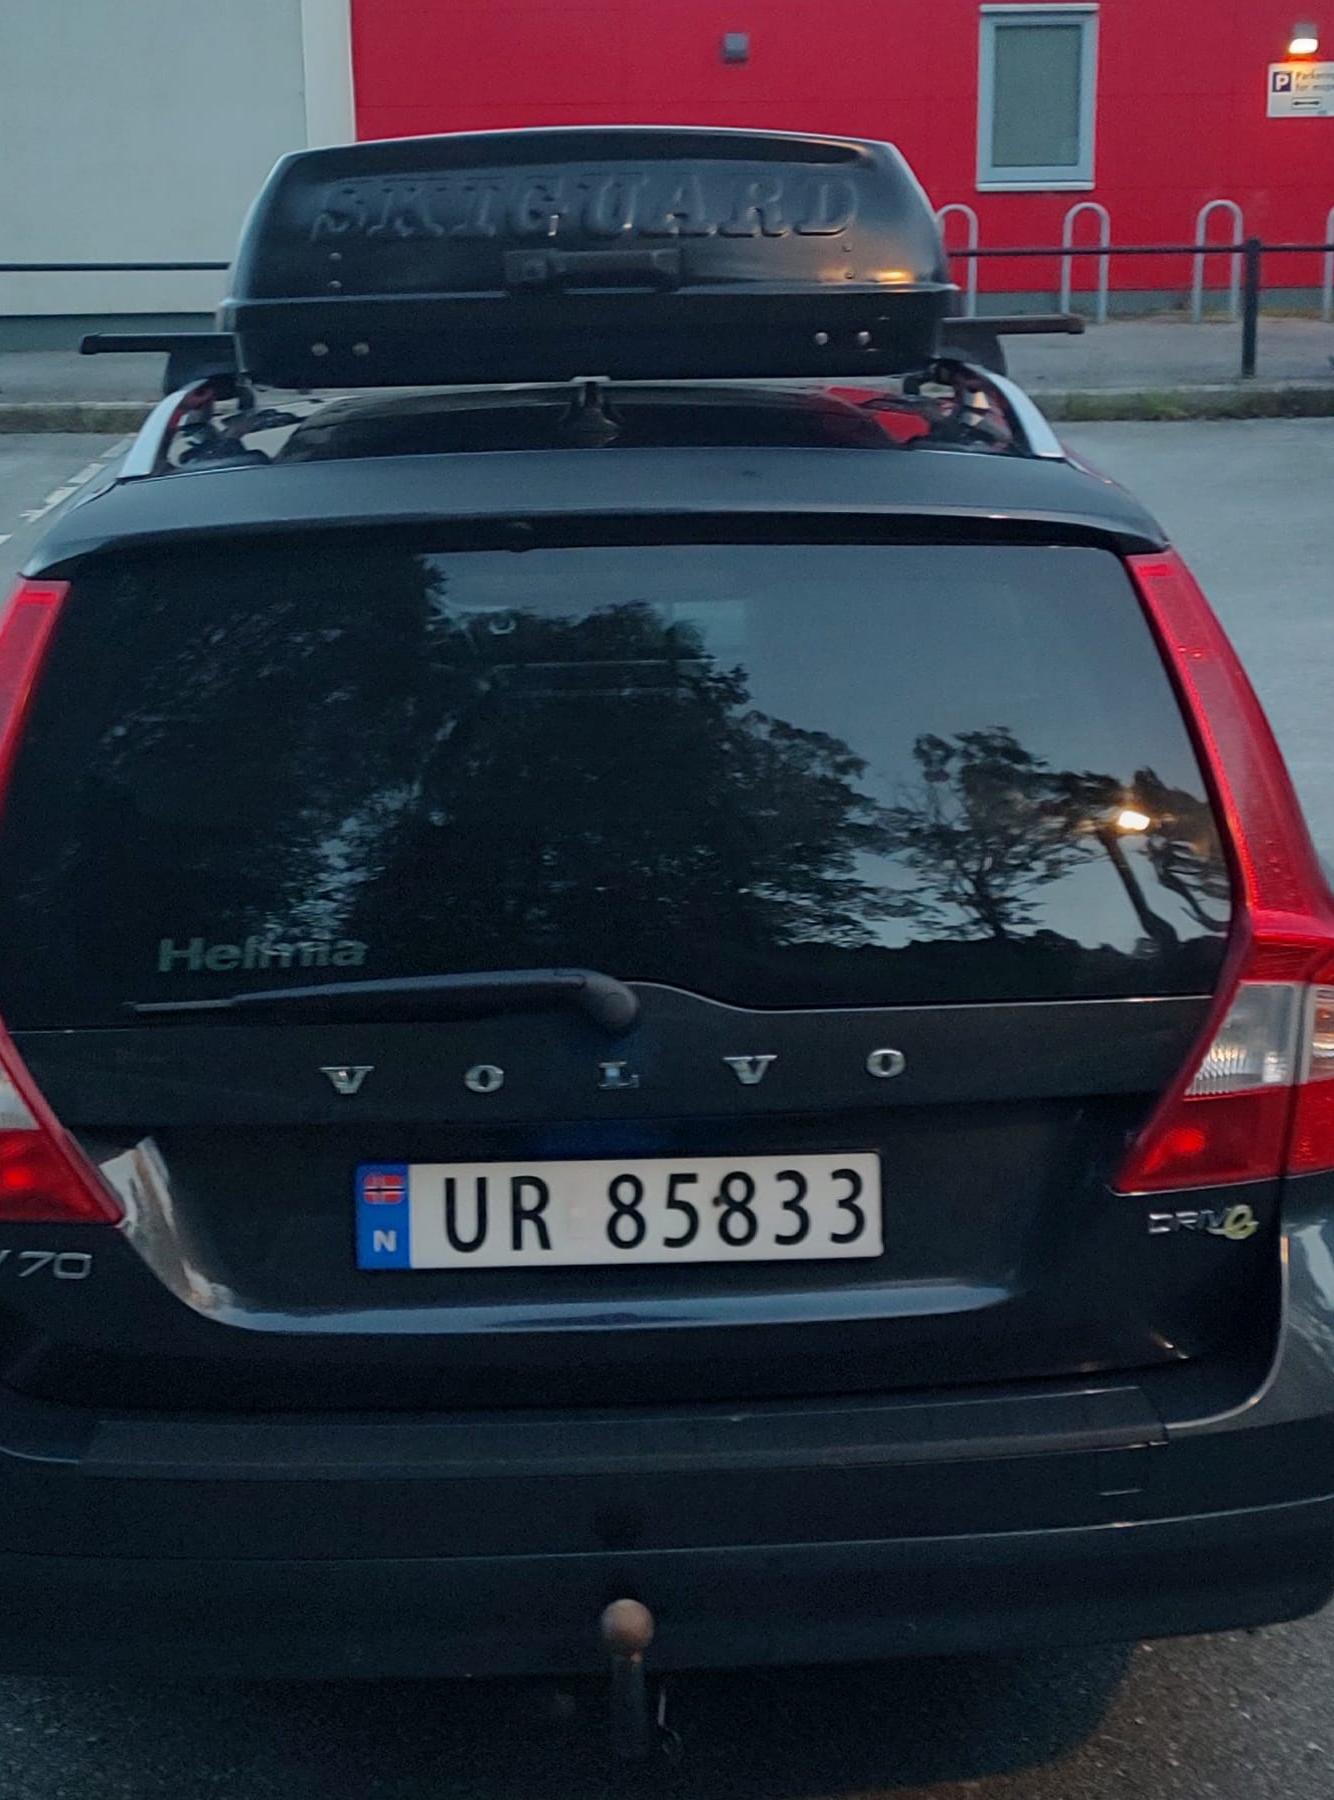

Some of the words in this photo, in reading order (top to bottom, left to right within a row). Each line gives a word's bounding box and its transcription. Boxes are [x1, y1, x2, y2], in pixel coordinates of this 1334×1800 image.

[1275, 73, 1289, 91] P
[310, 173, 860, 240] SKIGUARD
[319, 1047, 907, 1095] VOLVO
[373, 1229, 397, 1253] N
[442, 1174, 554, 1254] UR
[604, 1167, 867, 1251] 85833
